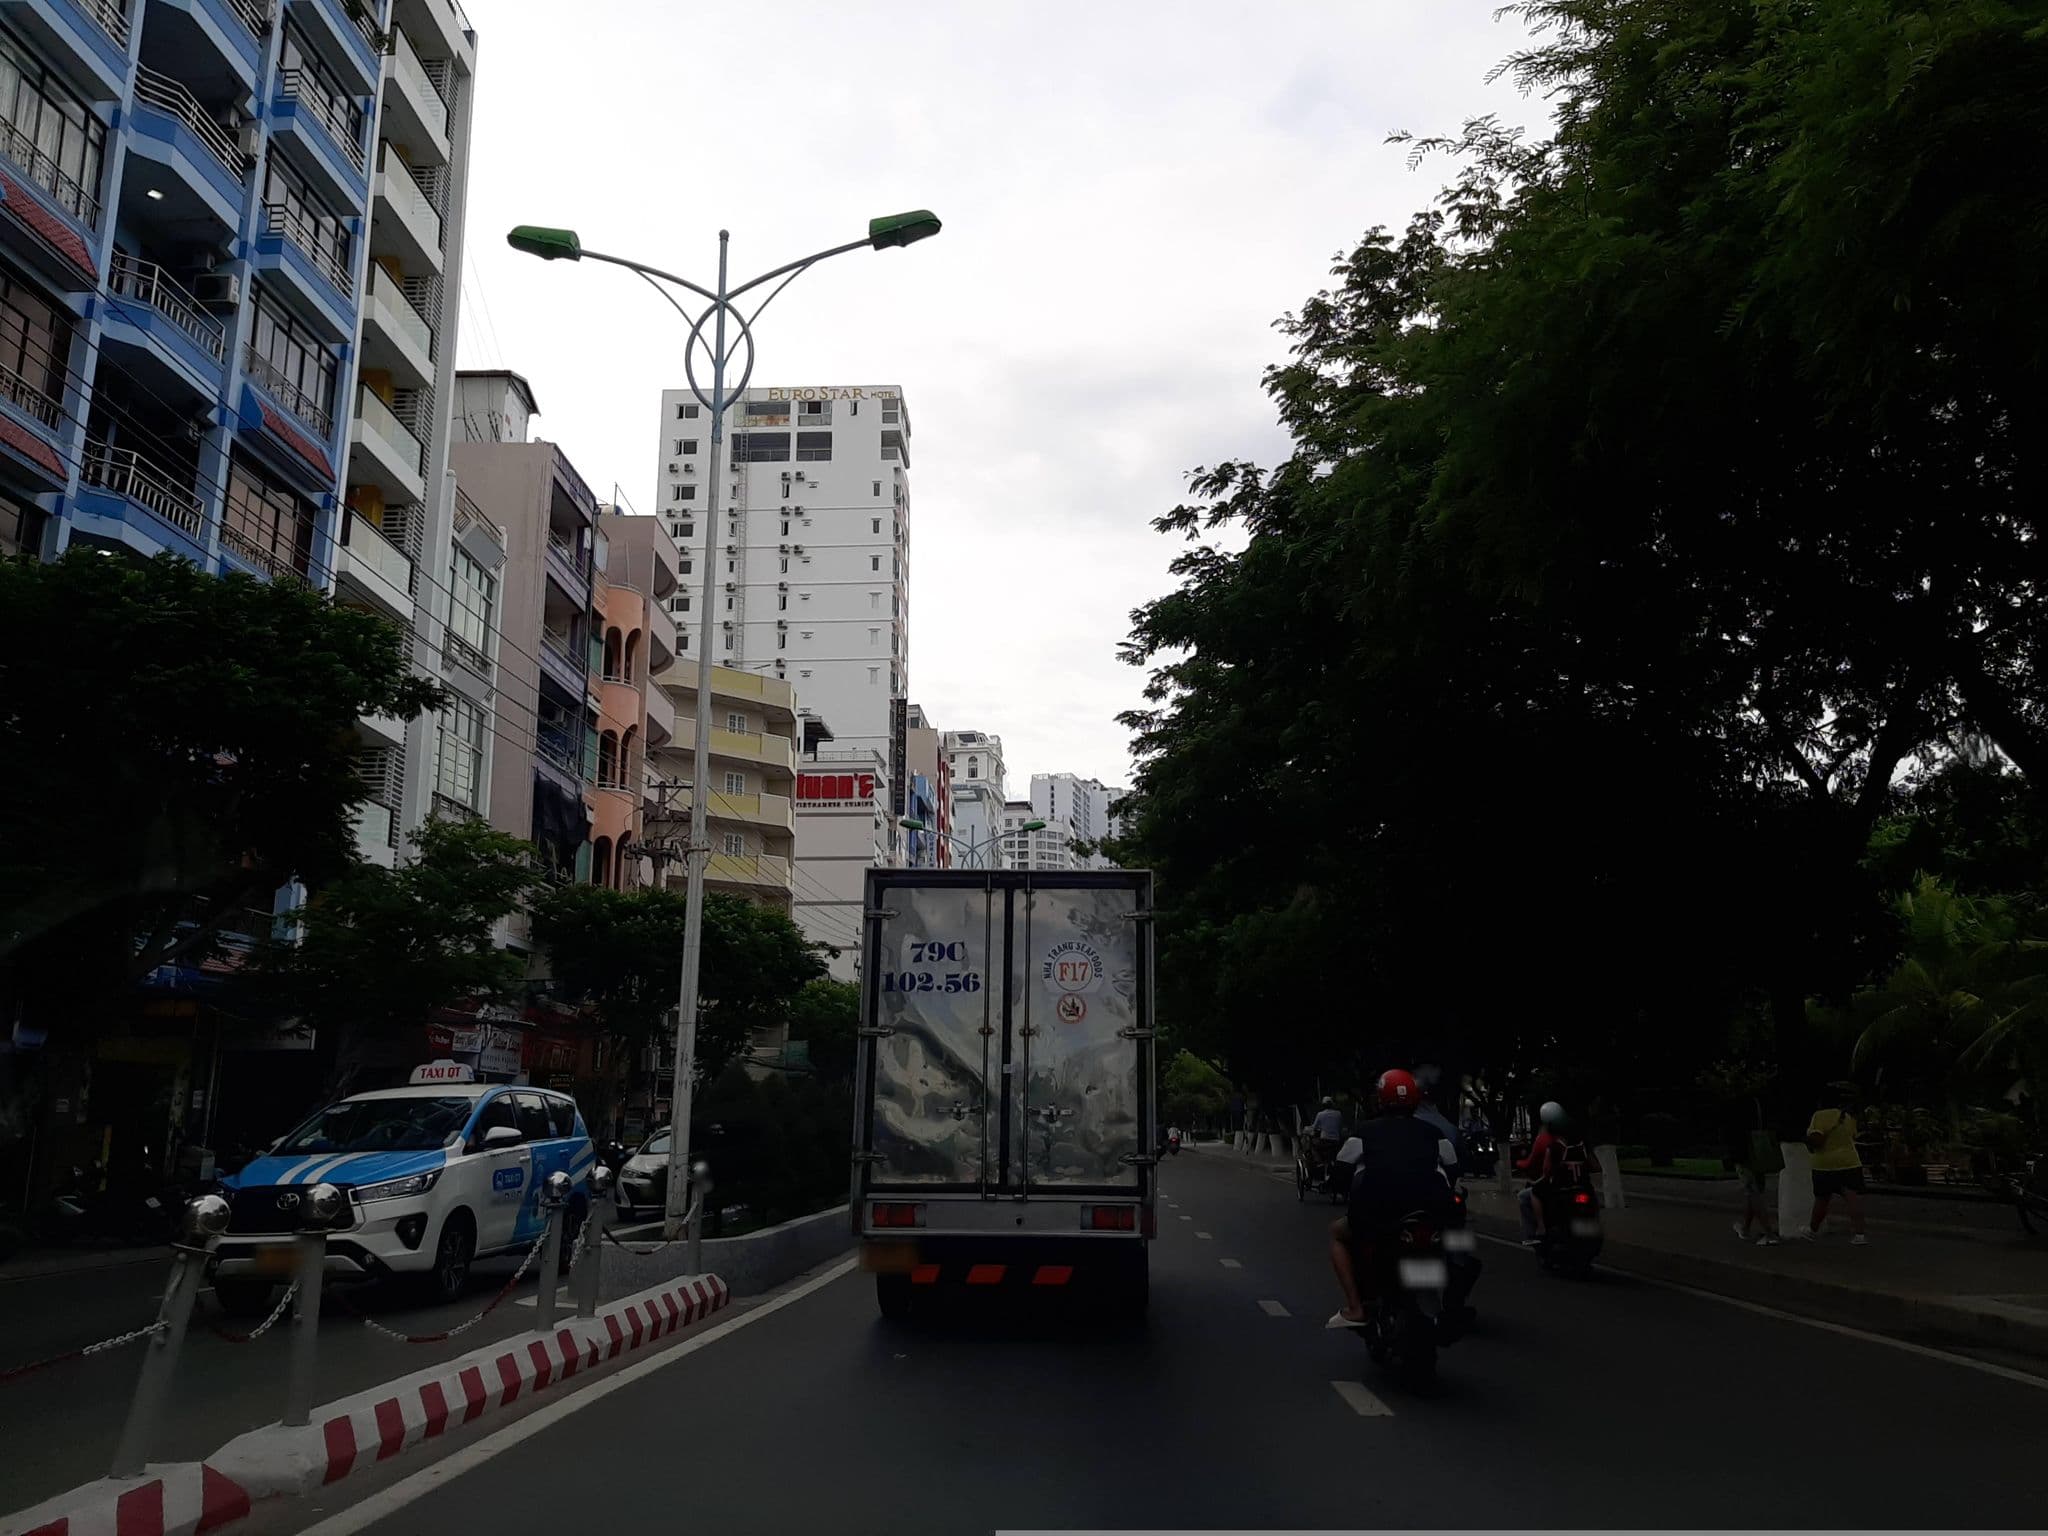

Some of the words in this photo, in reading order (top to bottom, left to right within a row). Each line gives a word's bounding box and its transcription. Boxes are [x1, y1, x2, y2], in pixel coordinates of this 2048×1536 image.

[768, 387, 815, 400] EURO
[819, 386, 868, 400] STAR
[910, 941, 966, 963] 79C
[1048, 942, 1074, 960] TRANG
[1076, 942, 1103, 978] SEAFOODS
[1058, 961, 1089, 982] F17
[881, 971, 981, 994] 102.56
[421, 1067, 444, 1079] TAXI
